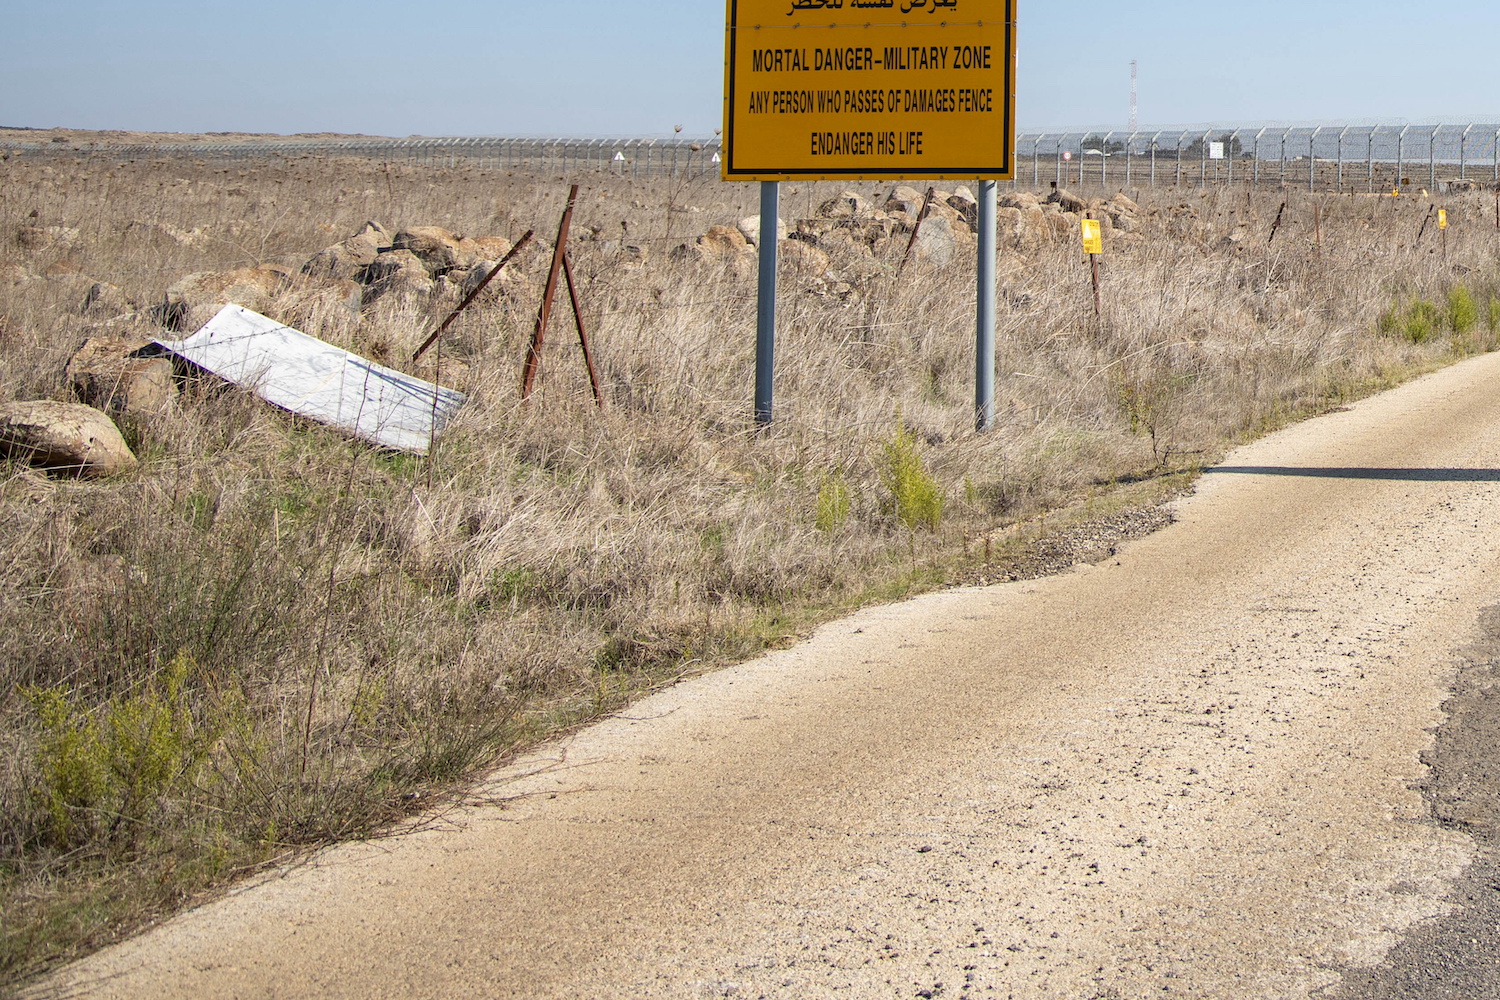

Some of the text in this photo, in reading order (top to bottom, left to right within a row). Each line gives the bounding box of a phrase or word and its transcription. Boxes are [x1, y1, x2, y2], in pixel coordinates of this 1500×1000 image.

[752, 48, 810, 73] MORTAL
[952, 45, 992, 70] ZONE
[748, 88, 993, 114] ANY PERSON WHO PASSES OF DAMAGES FENCE
[810, 131, 923, 156] ENDANGER HIS LIFE
